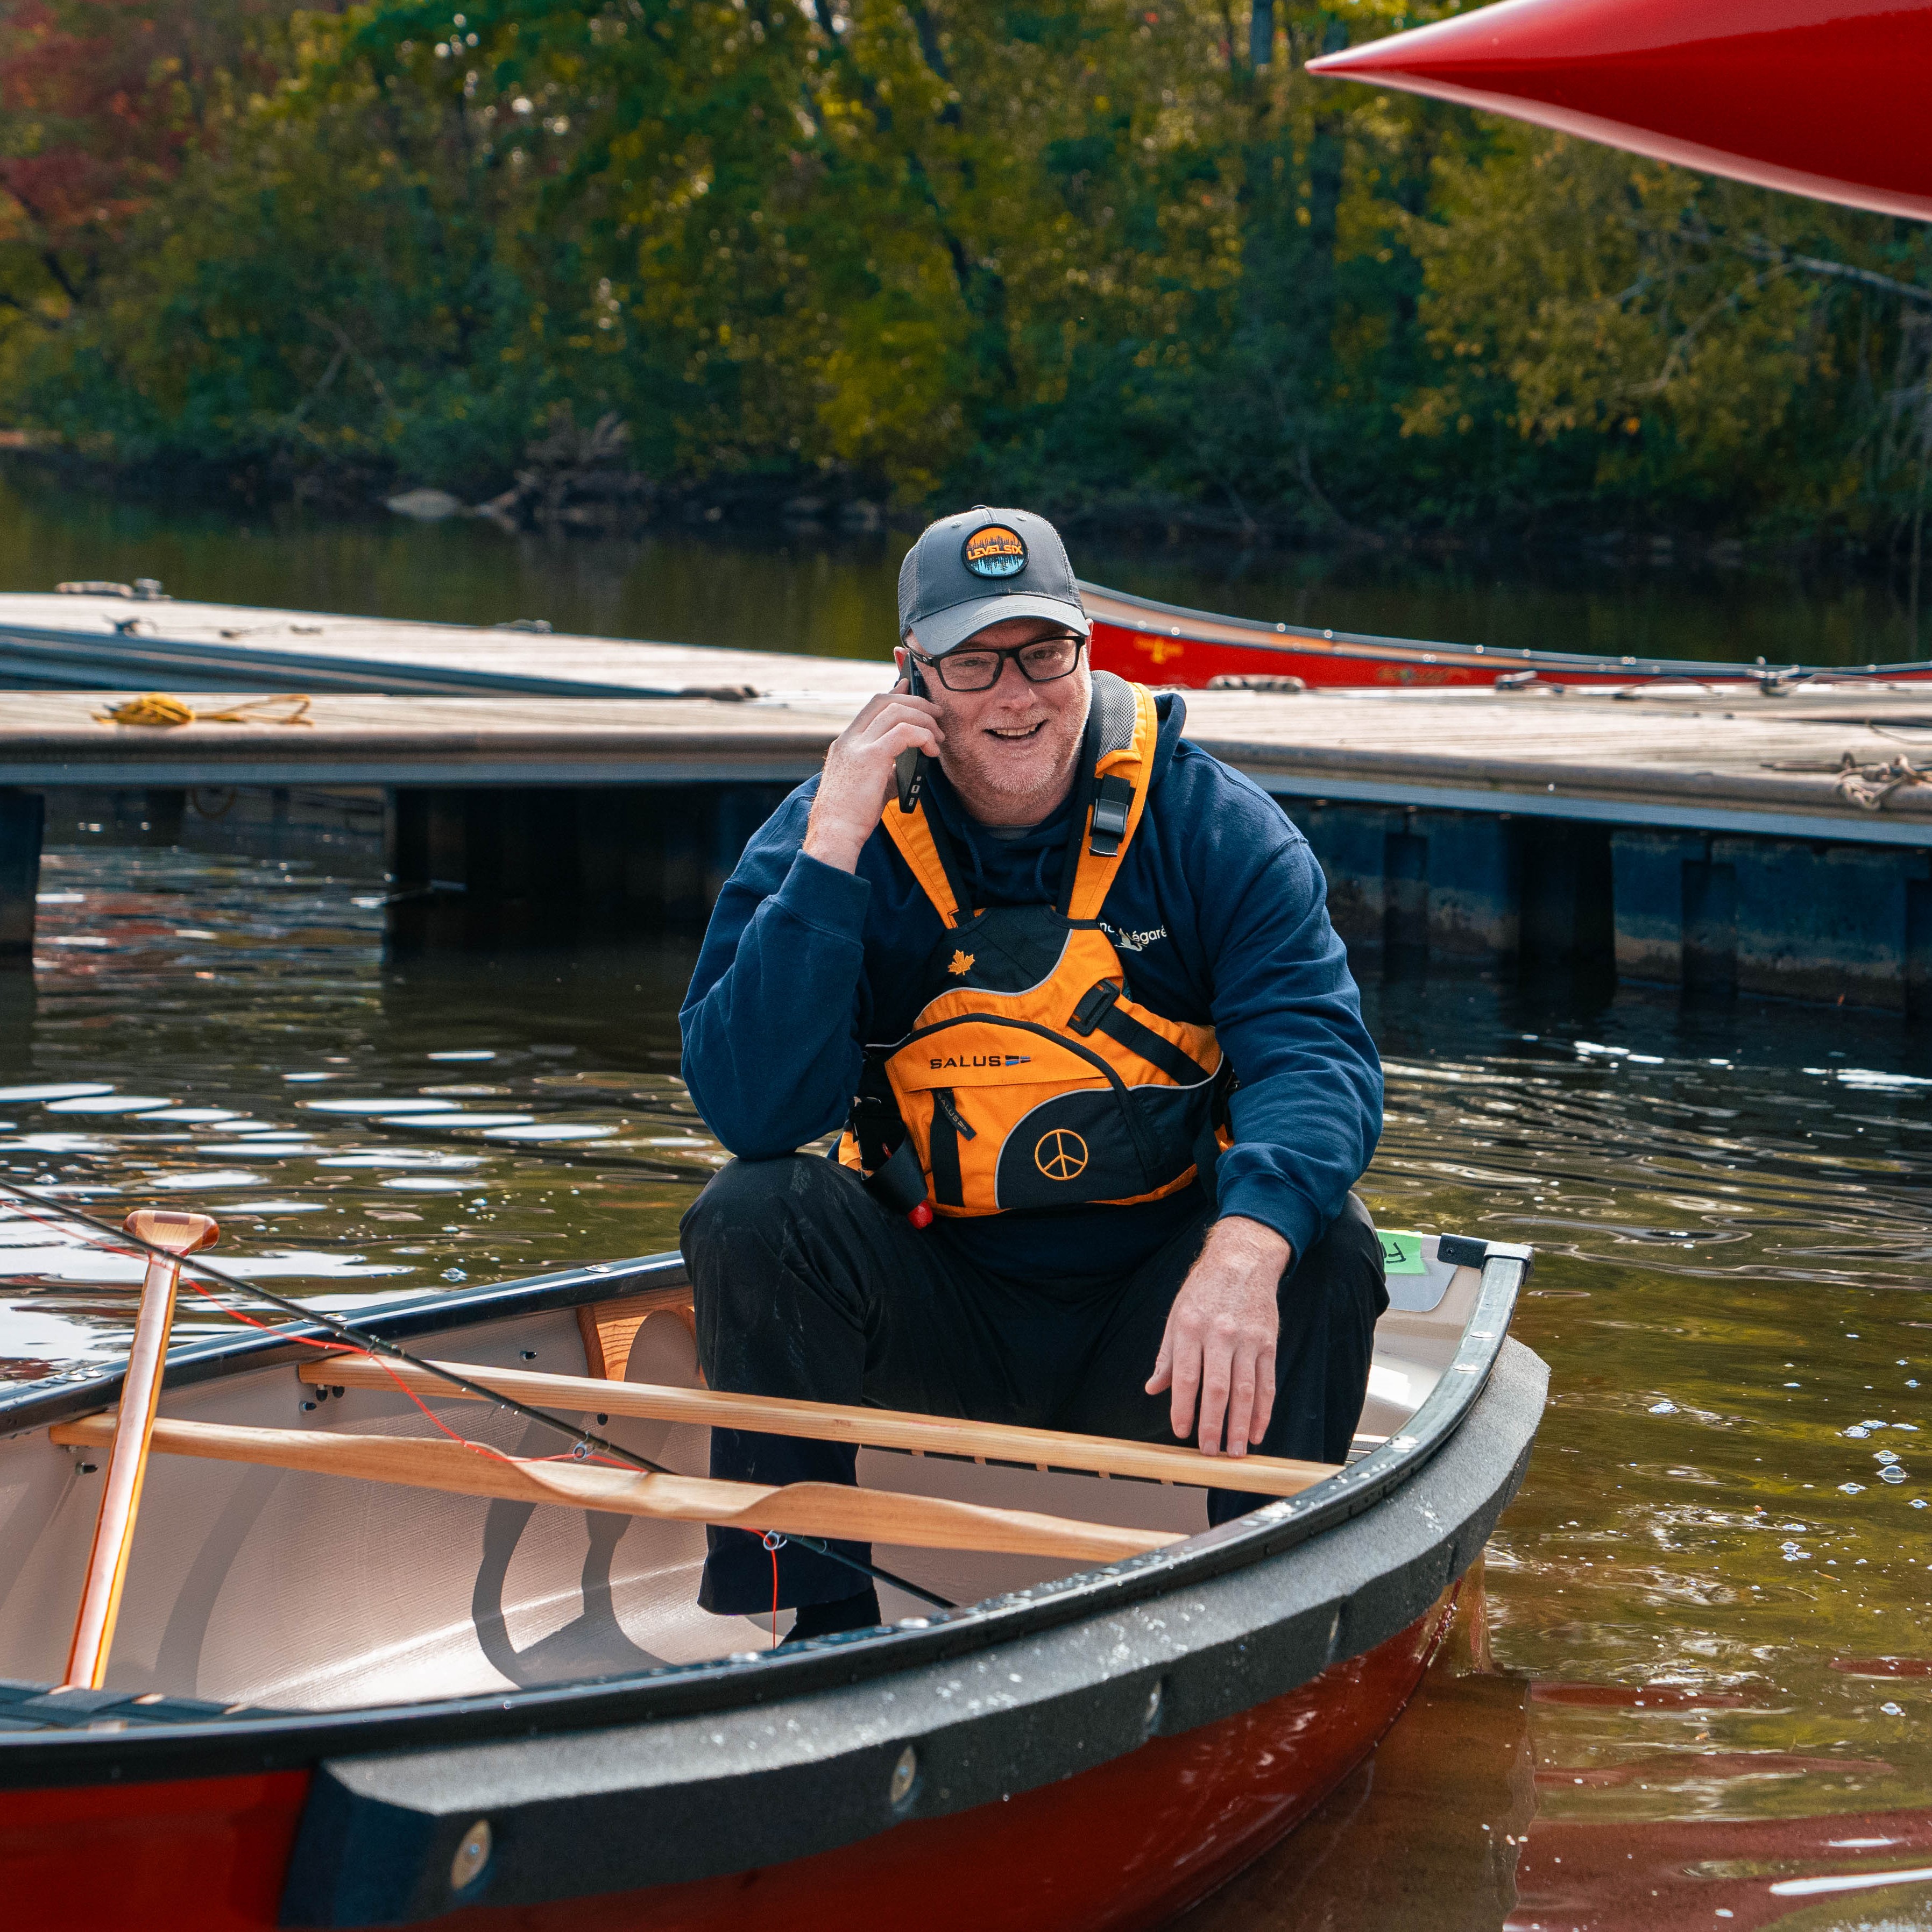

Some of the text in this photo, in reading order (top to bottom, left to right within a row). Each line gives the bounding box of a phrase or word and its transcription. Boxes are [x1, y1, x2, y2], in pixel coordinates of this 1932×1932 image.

[967, 544, 1023, 560] LEVEL SIX
[930, 1055, 1001, 1070] SALUS
